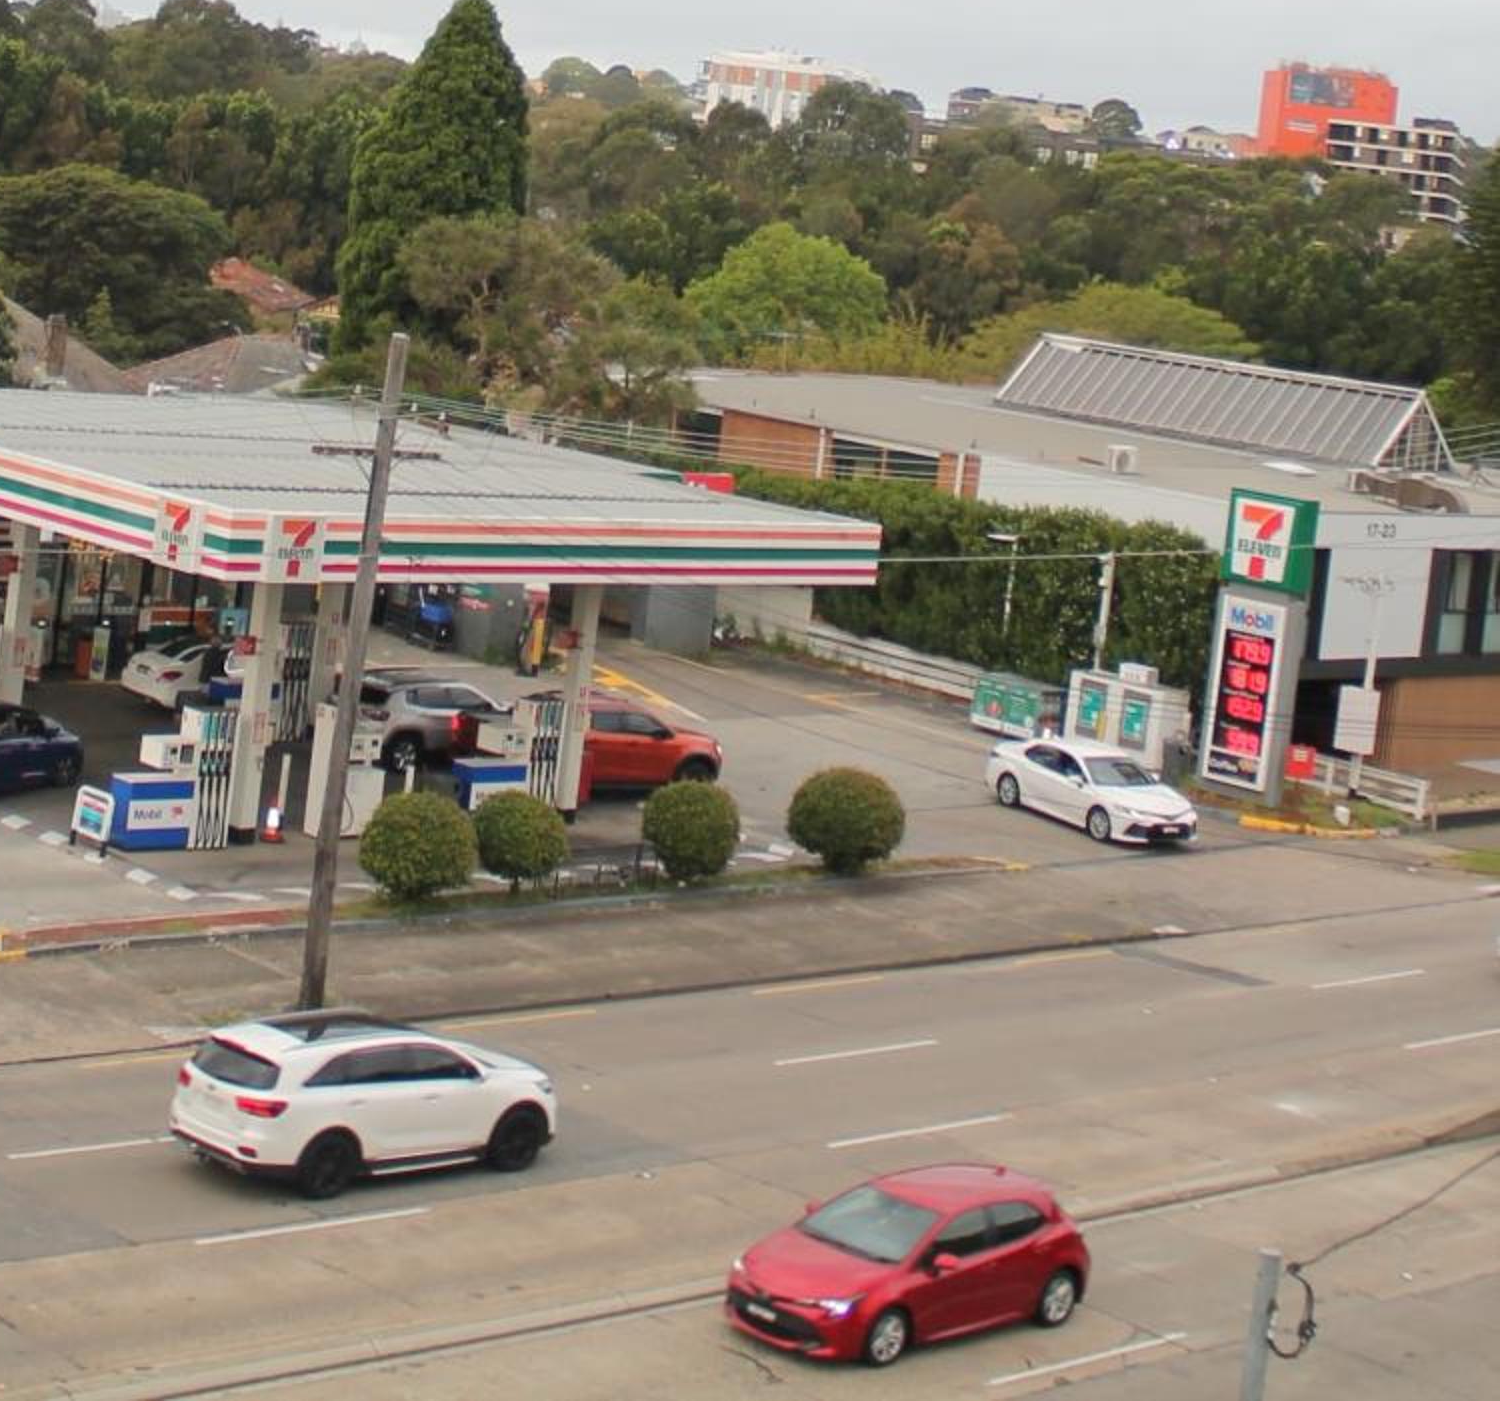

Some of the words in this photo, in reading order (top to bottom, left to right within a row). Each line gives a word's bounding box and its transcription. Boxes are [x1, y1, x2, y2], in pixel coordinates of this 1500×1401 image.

[164, 502, 191, 561] 7
[282, 519, 317, 577] 7
[1242, 503, 1285, 580] 7
[1367, 523, 1397, 538] 17-23
[1231, 608, 1274, 631] Mobil
[133, 808, 164, 821] Mobil
